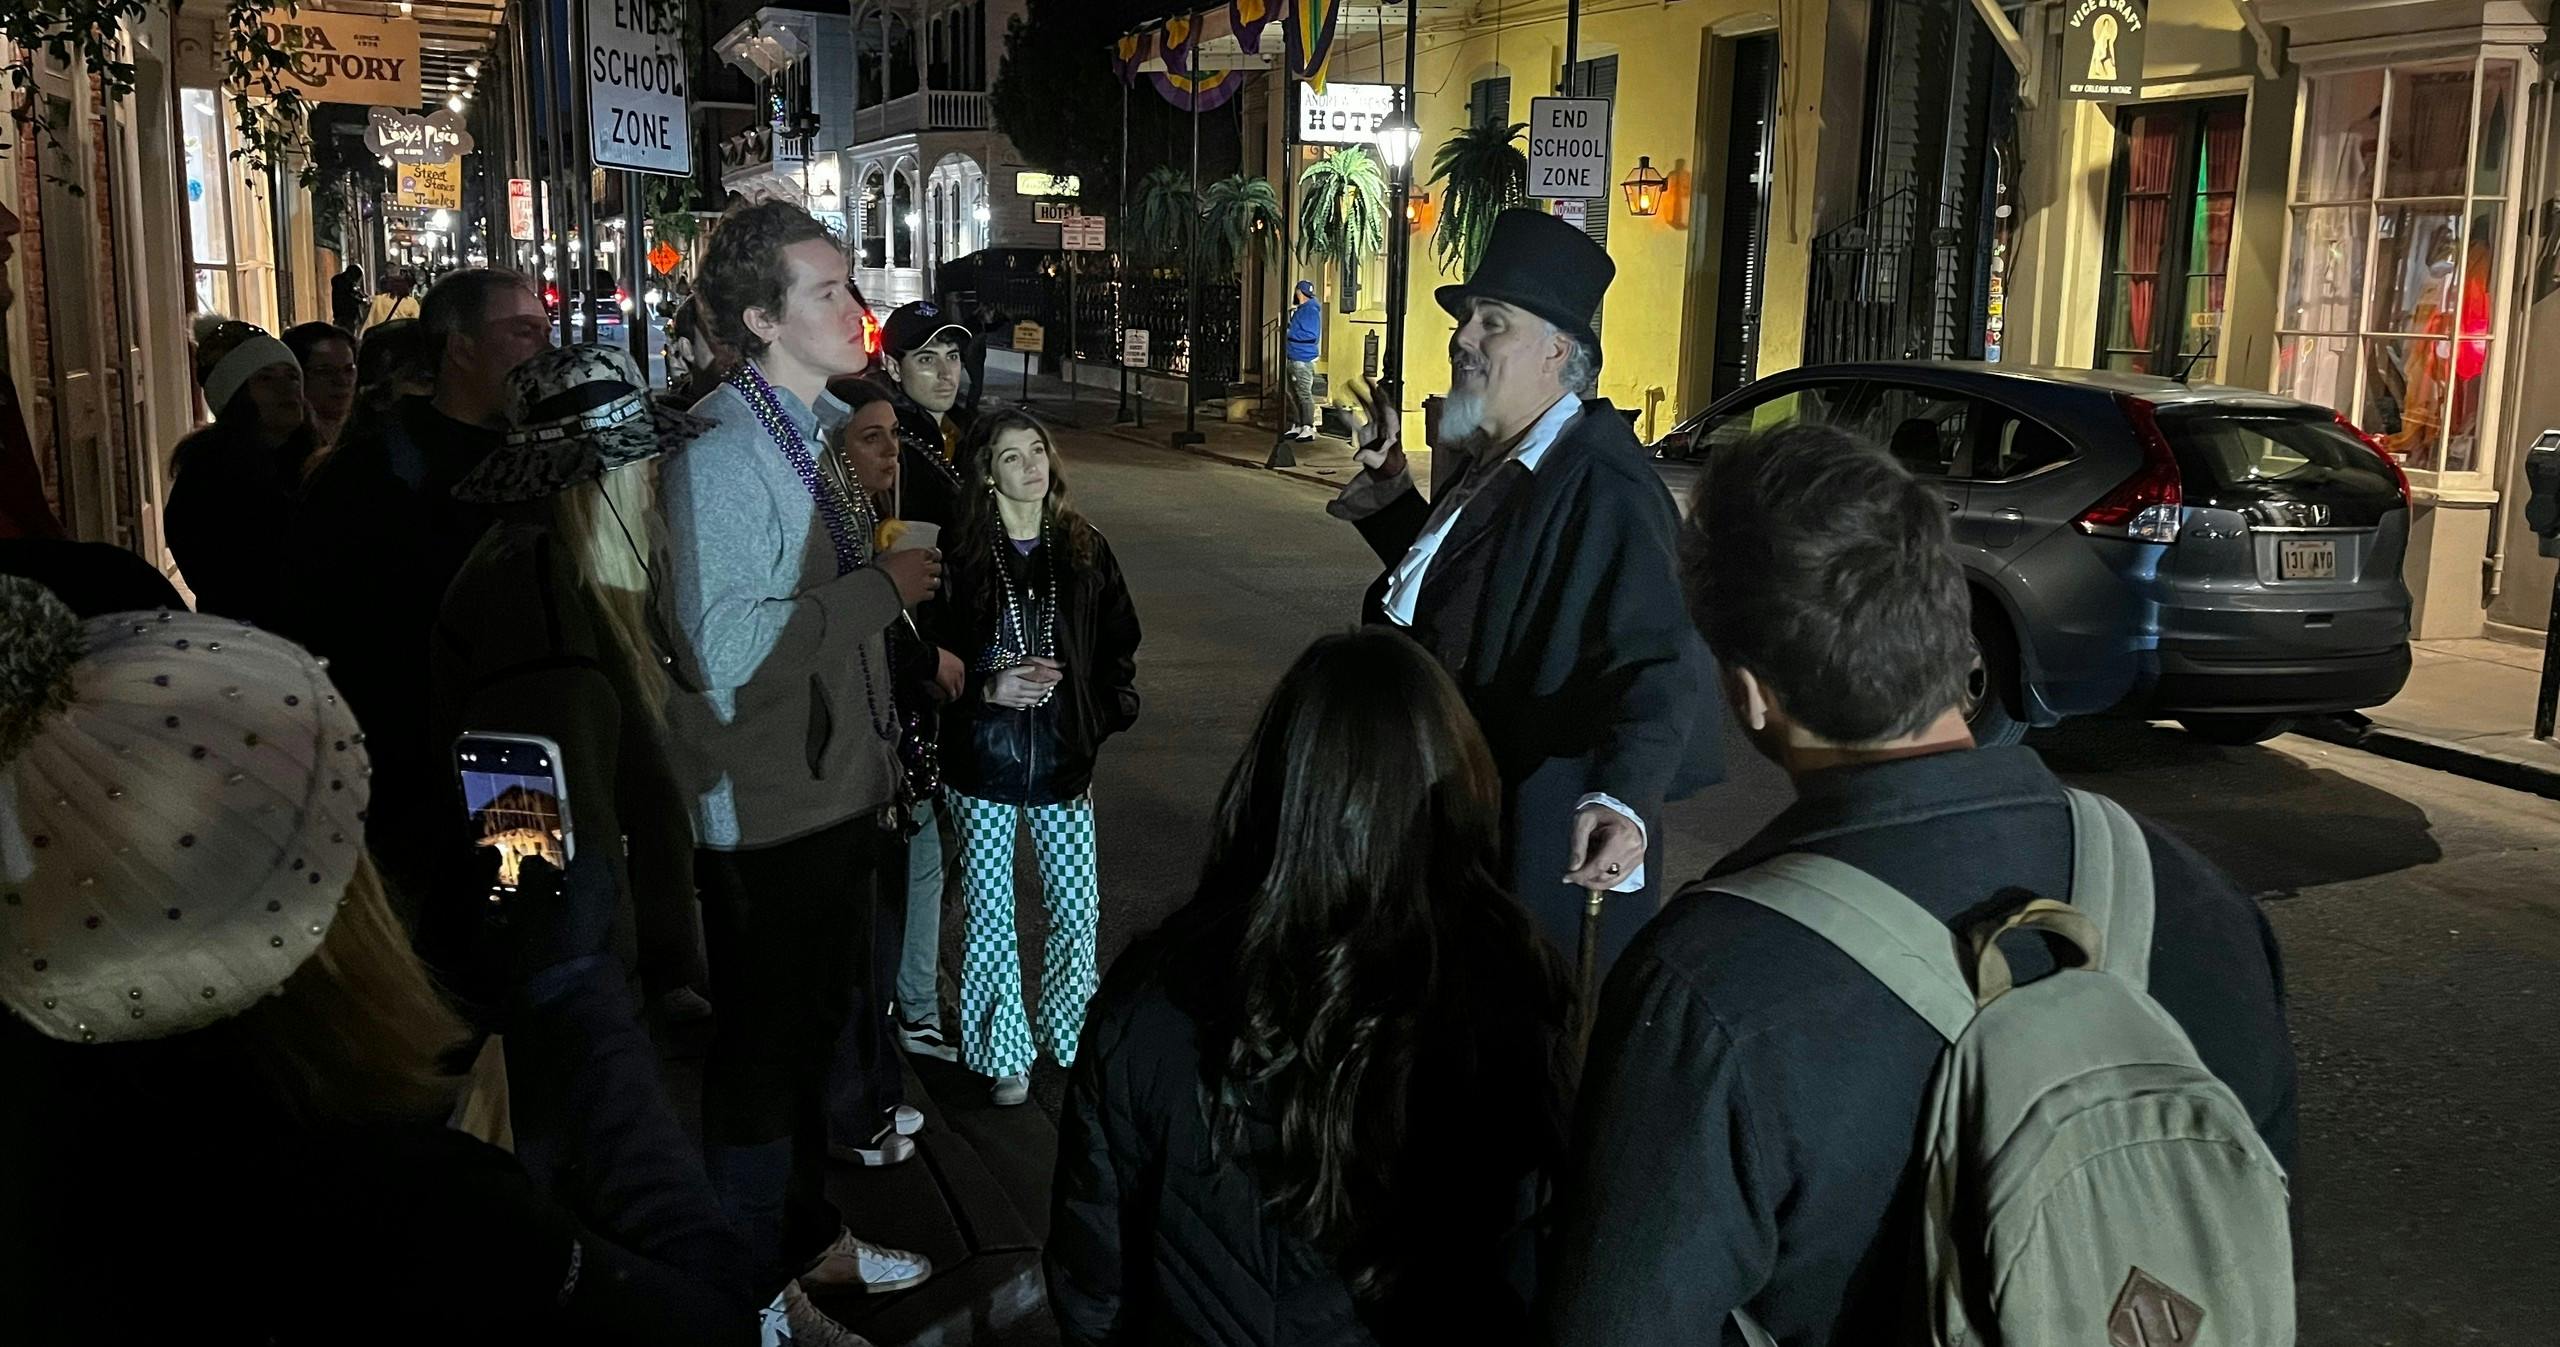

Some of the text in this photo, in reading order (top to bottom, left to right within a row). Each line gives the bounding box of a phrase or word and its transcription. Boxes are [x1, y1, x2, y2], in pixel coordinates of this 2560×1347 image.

[2070, 0, 2098, 28] VICE
[250, 21, 336, 50] DEA
[593, 46, 684, 97] SCHOOL
[611, 107, 672, 150] ZONE
[1308, 109, 1384, 133] HOTE
[1552, 109, 1588, 128] END
[1533, 138, 1604, 158] SCHOOL
[1542, 167, 1591, 186] ZONE
[2285, 551, 2304, 569] 131
